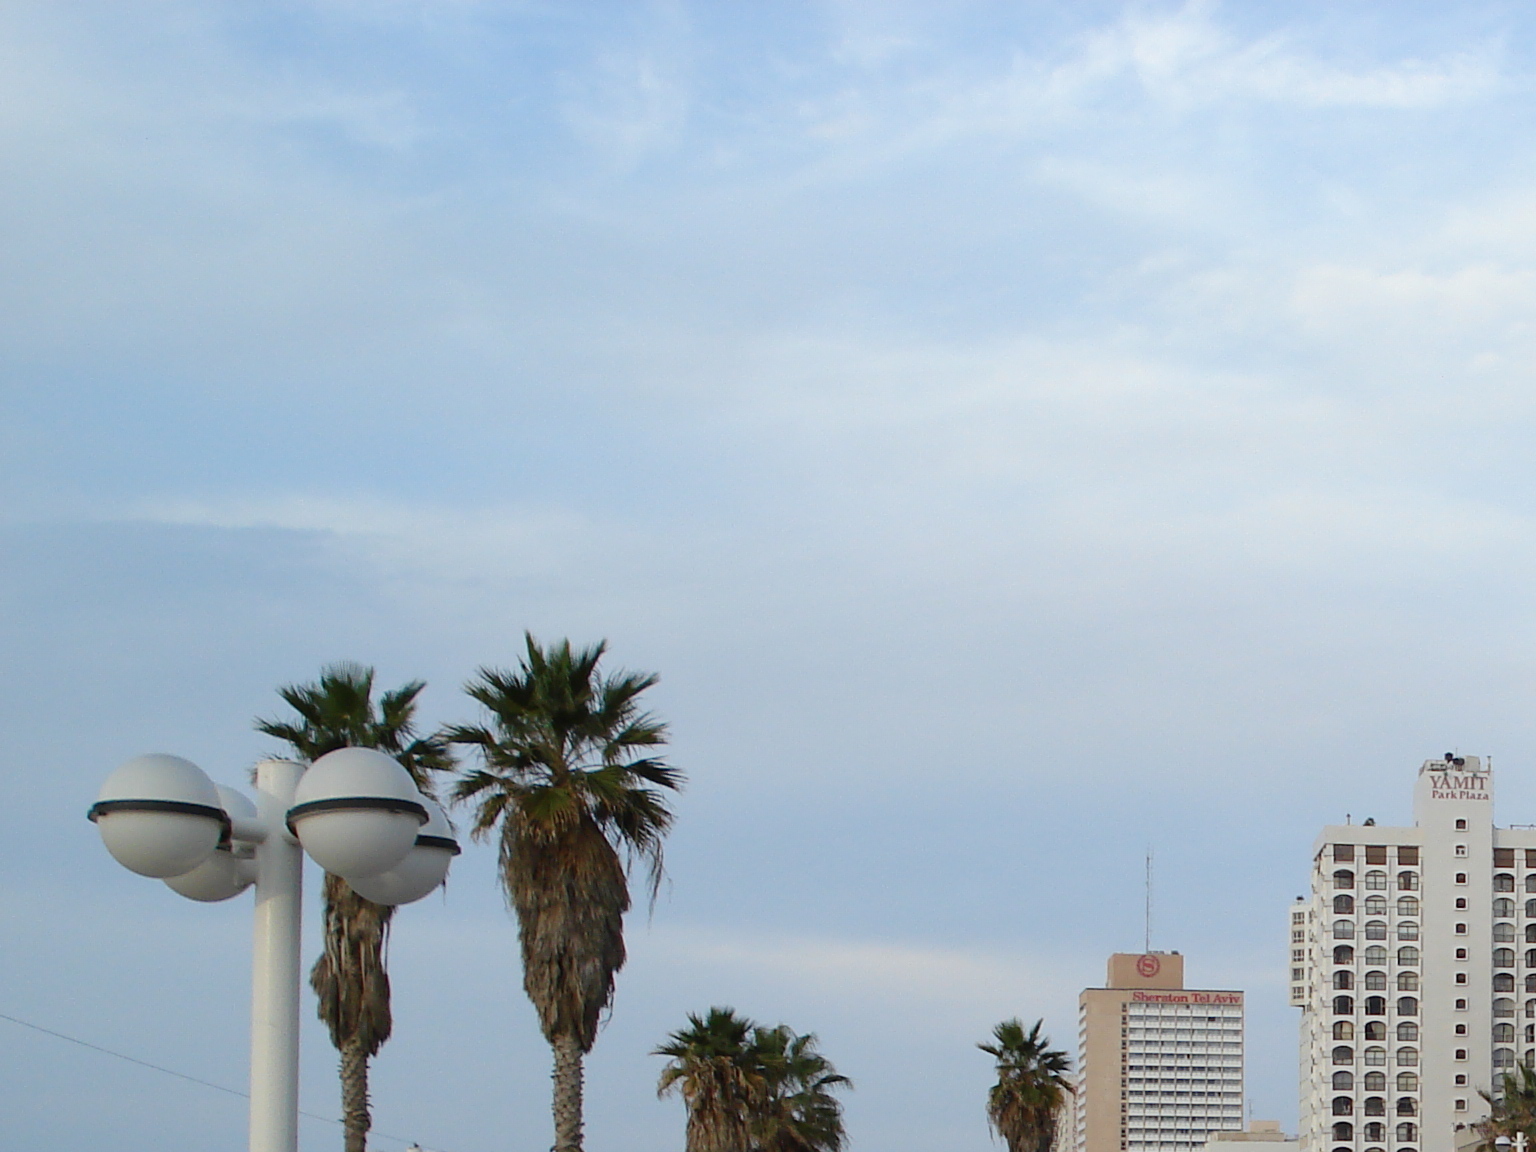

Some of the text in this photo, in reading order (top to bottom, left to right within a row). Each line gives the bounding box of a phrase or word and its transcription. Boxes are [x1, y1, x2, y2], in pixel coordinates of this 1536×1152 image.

[1429, 775, 1488, 790] YAMIT
[1432, 790, 1489, 800] Park Plaza
[1133, 991, 1240, 1003] Sheraton Tel Aviv
